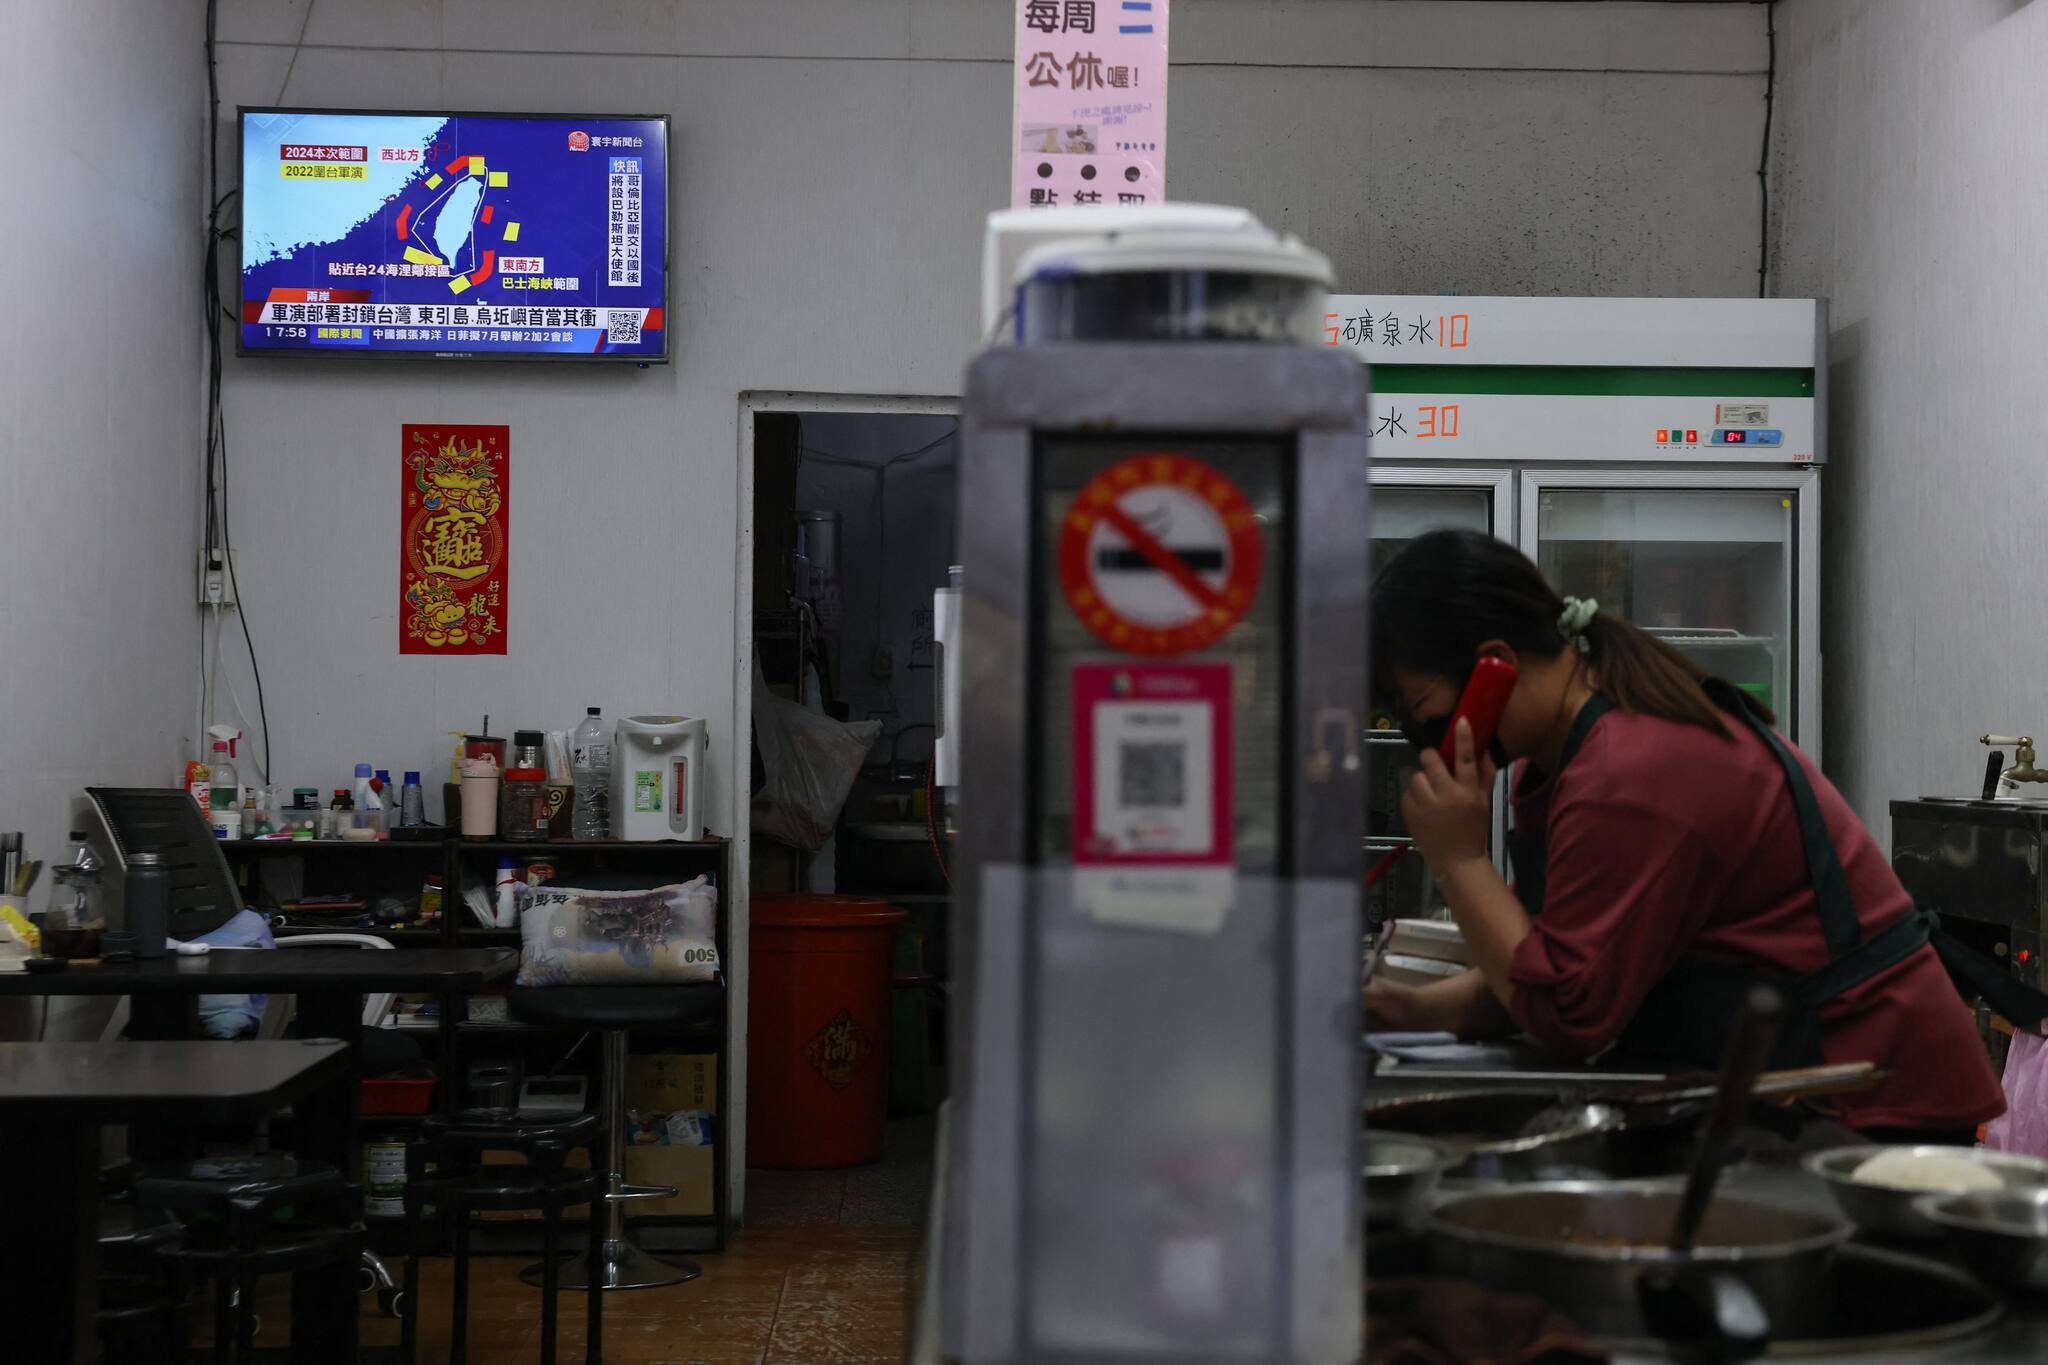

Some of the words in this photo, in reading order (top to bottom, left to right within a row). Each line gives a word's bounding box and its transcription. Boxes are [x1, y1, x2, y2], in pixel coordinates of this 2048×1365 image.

[1025, 0, 1096, 34] 每周
[1119, 1, 1153, 34] 二
[591, 136, 643, 148] 寰宇新聞台
[285, 147, 363, 160] 2024本次範圍
[381, 149, 419, 161] 西北方
[285, 165, 363, 179] 2022圍台軍演
[613, 159, 640, 174] 快訊
[611, 175, 624, 282] 將設巴勒斯坦大使館
[627, 175, 640, 283] 哥倫比亞斷交以國後
[503, 259, 540, 271] 東南方
[502, 277, 579, 290] 巴士海峽範圍
[306, 290, 330, 302] 兩岸
[271, 304, 412, 325] 軍演部署封鎖台灣
[265, 327, 307, 338] 17:58
[1342, 308, 1433, 347] 礦泉水
[1439, 313, 1468, 348] 10
[1368, 405, 1407, 438] 水
[1416, 404, 1459, 438] 30
[685, 948, 715, 963] 500
